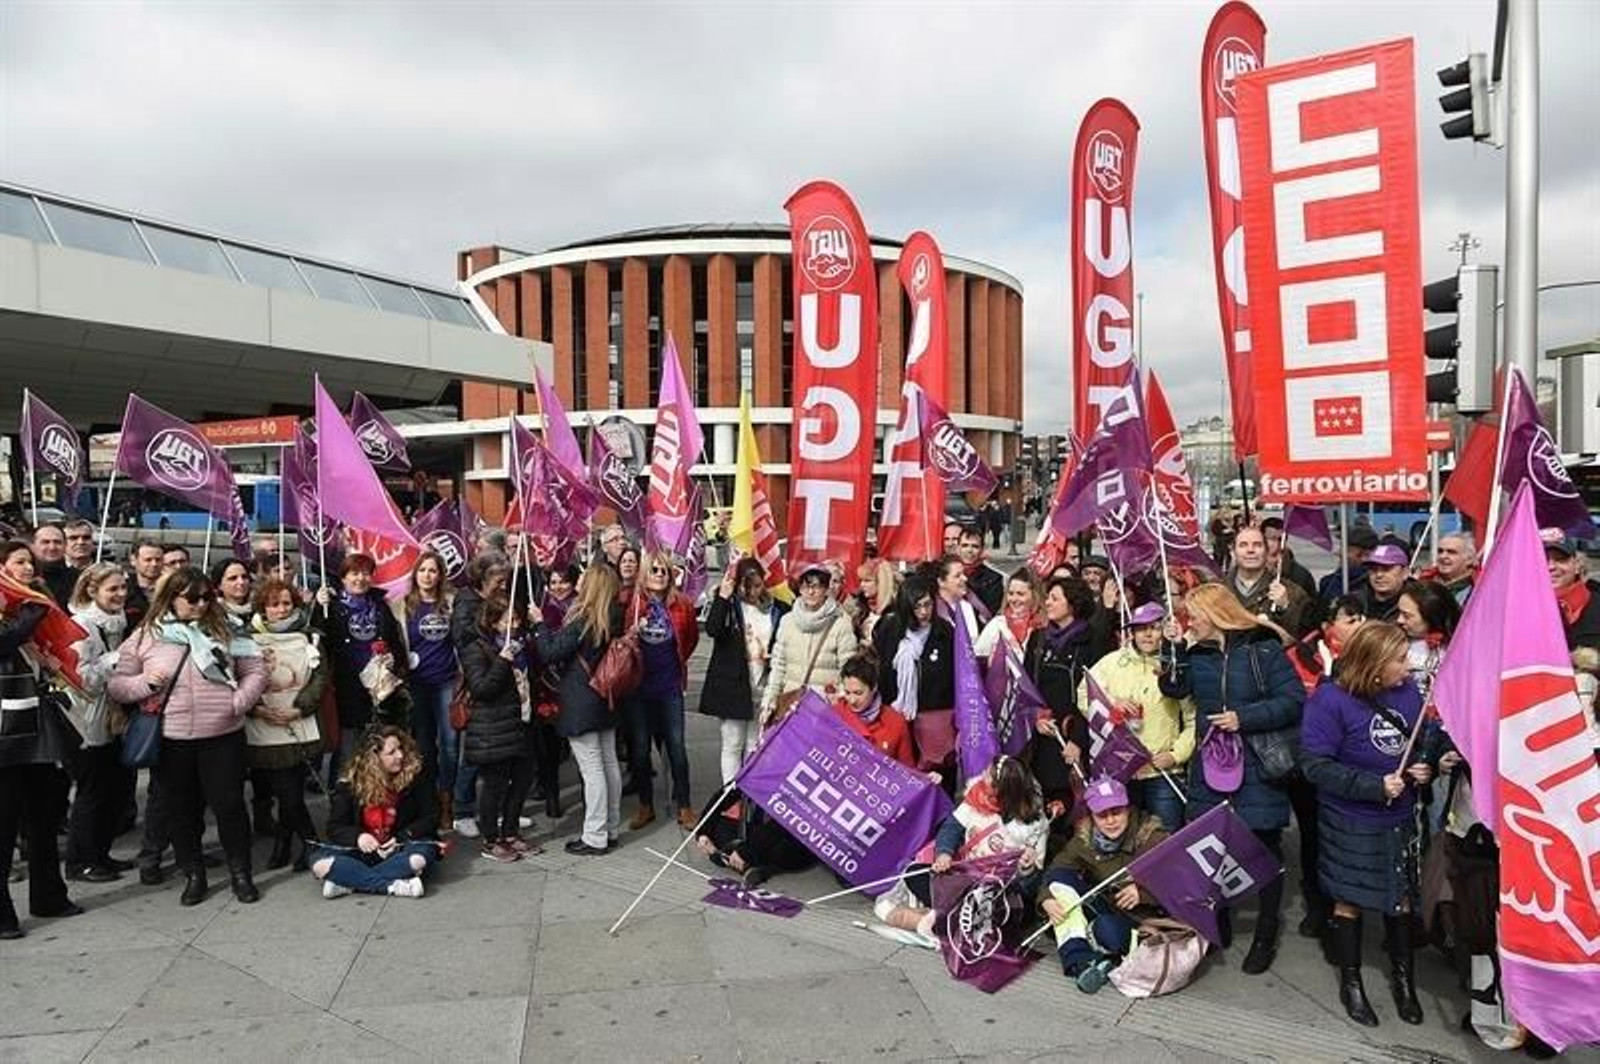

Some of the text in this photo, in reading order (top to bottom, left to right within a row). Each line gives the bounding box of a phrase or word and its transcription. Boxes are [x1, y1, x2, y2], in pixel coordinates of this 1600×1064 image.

[1094, 140, 1122, 174] UGT
[1266, 61, 1393, 462] CCOO
[46, 429, 77, 472] UGT
[154, 433, 204, 472] UGT
[935, 425, 975, 467] UGT
[1260, 468, 1428, 495] ferroviario
[808, 748, 905, 822] mujeres!
[837, 743, 900, 795] de las
[786, 761, 886, 847] CCOO
[767, 792, 858, 873] ferroviario
